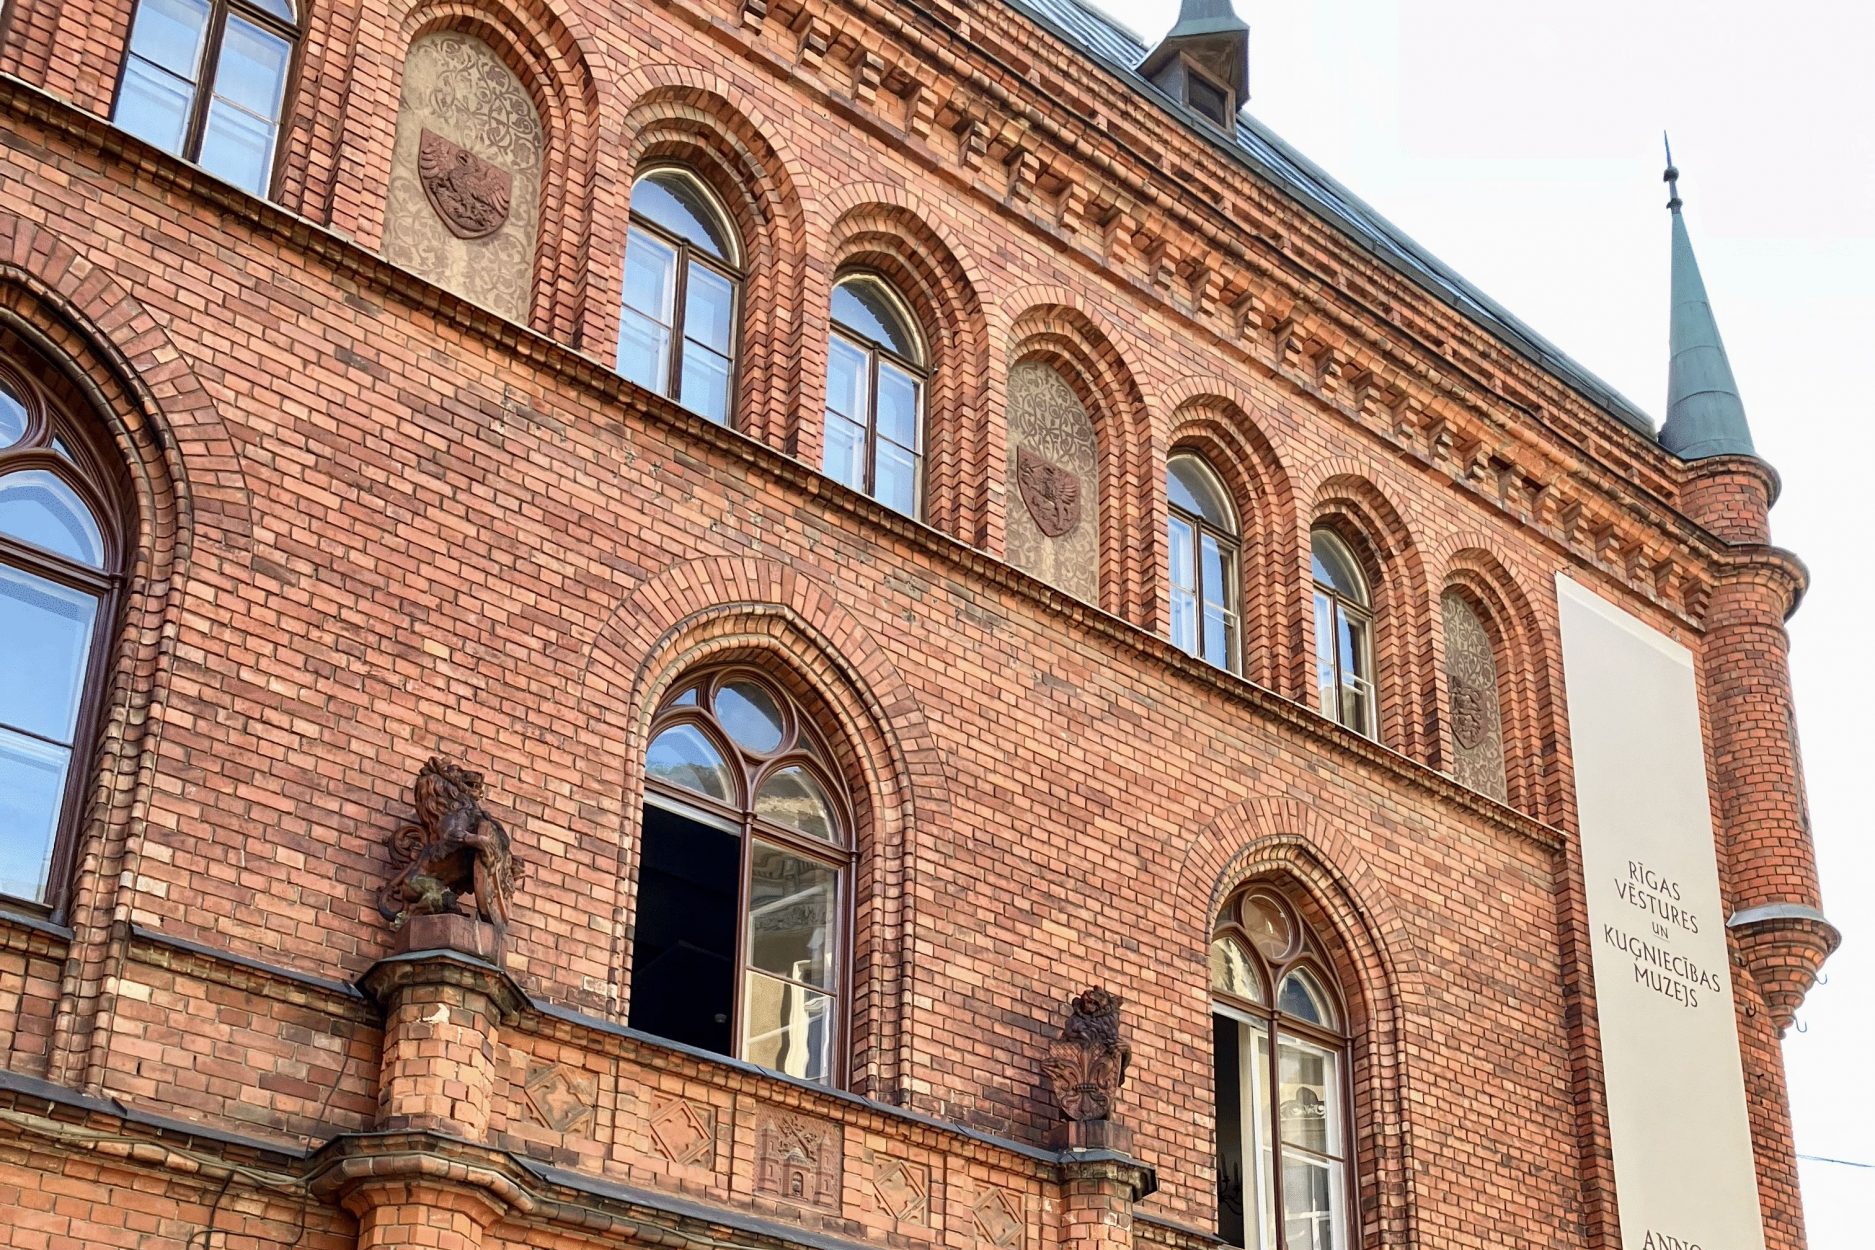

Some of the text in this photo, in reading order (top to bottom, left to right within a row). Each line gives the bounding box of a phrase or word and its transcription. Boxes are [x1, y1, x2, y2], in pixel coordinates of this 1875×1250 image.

[1628, 860, 1681, 901] RĪGAS
[1614, 878, 1699, 934] VĒSTURES
[1652, 921, 1669, 939] UN
[1604, 923, 1721, 993] KUĢNIECĪBAS
[1633, 962, 1698, 1008] MUZEJS
